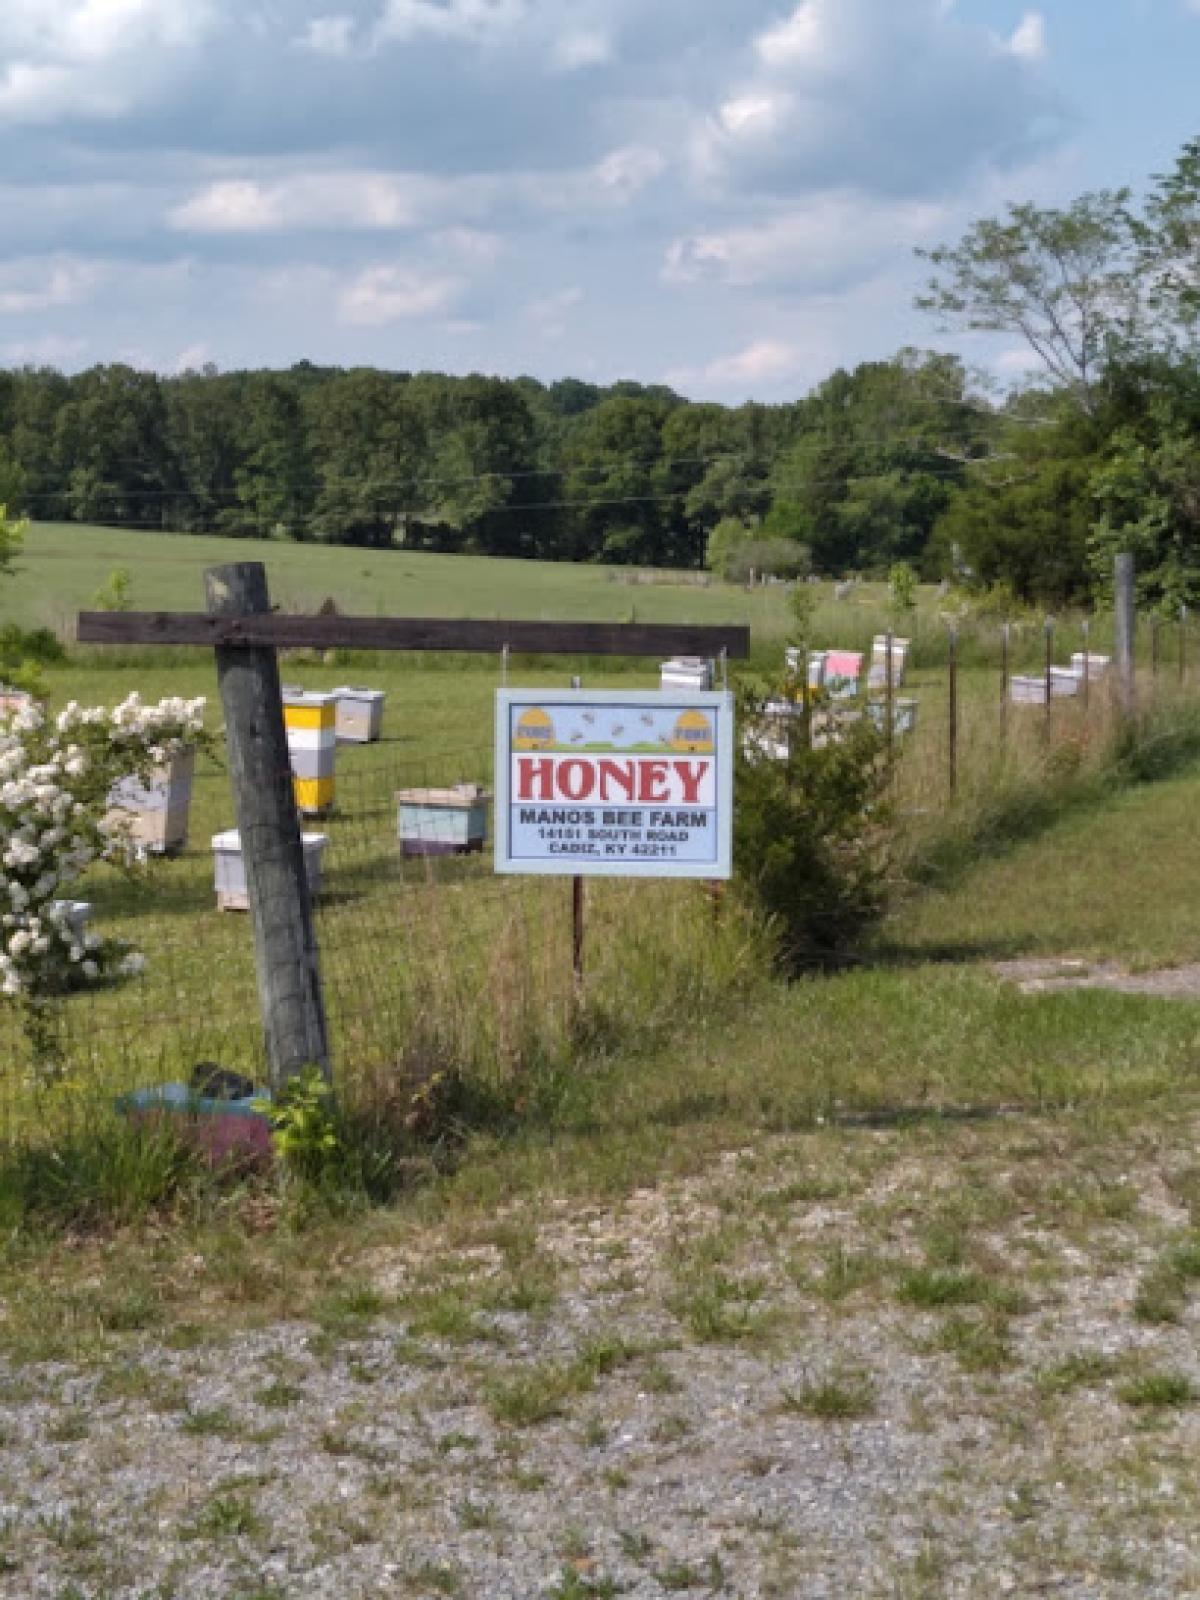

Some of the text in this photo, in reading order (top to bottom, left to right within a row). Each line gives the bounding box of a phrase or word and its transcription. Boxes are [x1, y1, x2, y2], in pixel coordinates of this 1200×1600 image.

[517, 758, 709, 804] HONEY
[602, 810, 642, 827] BEE
[649, 810, 707, 828] FARM
[587, 828, 641, 842] SOUTH
[646, 830, 689, 842] ROAD
[605, 844, 626, 856] KY
